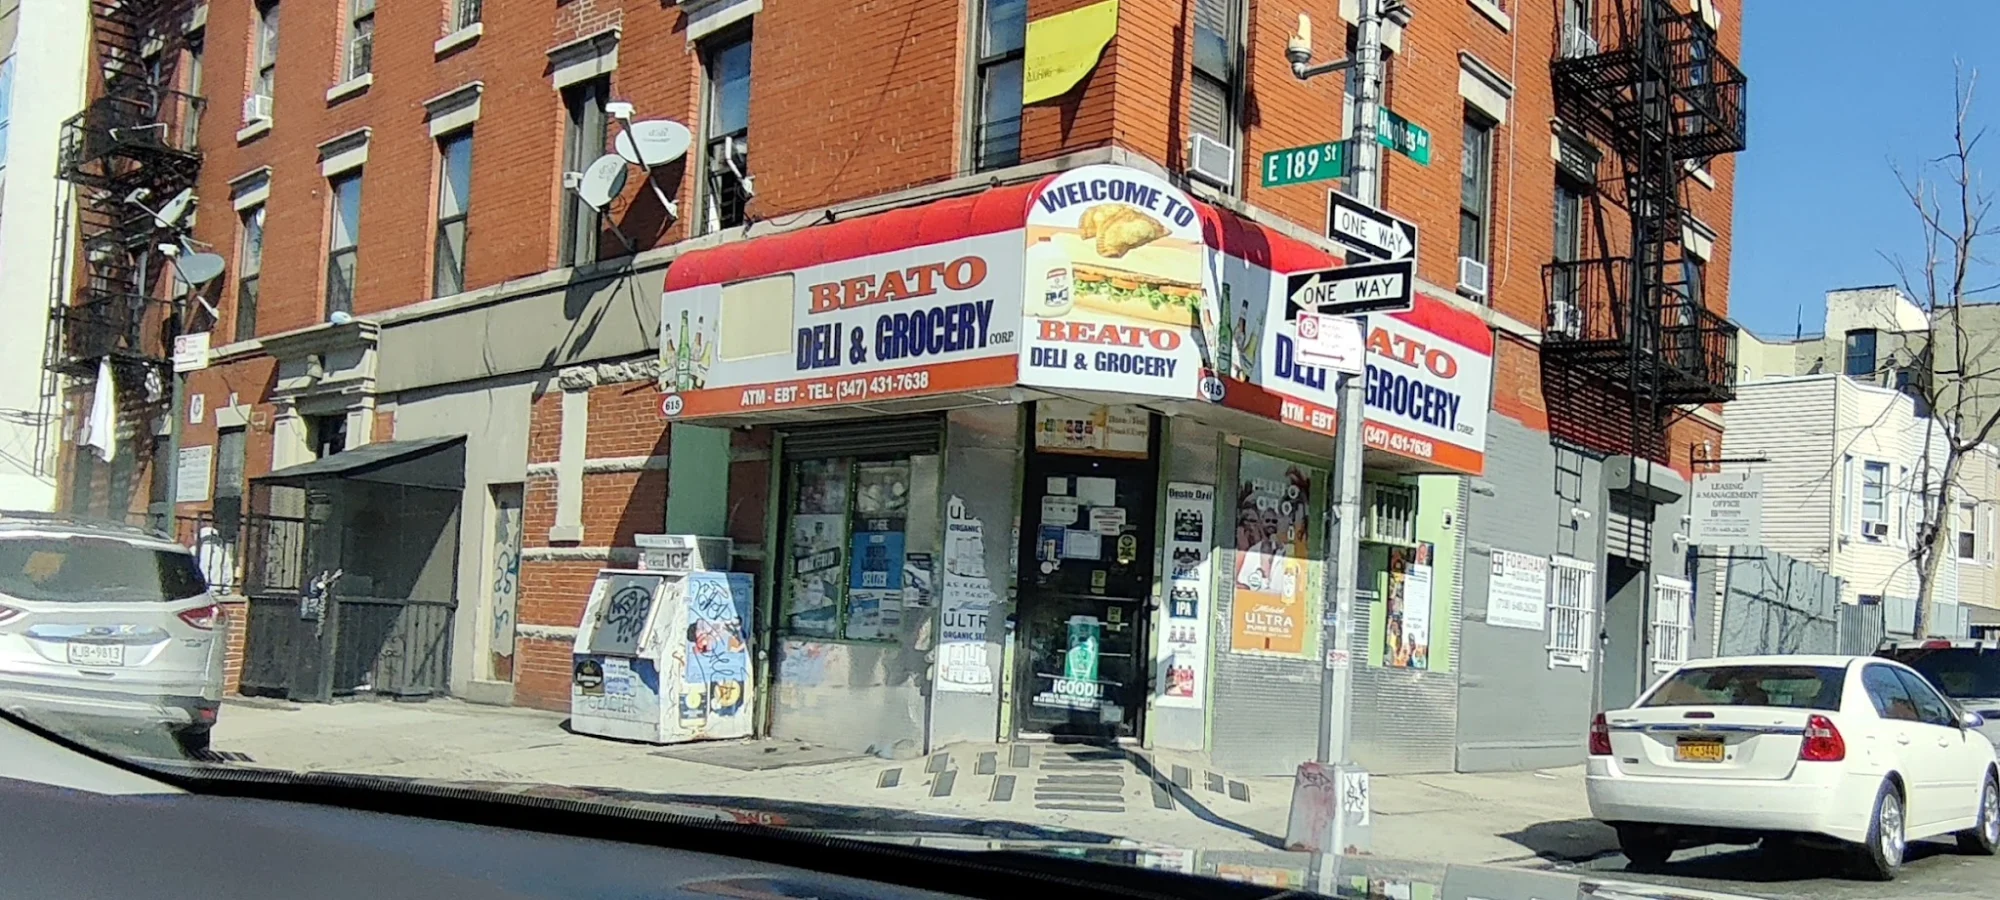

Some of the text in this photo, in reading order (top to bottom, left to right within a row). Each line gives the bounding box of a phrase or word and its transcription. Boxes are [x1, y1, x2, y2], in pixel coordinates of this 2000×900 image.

[1379, 109, 1427, 152] Hughes Av
[1268, 144, 1337, 182] E 189 St
[1038, 179, 1196, 228] WELCOME TO
[1342, 212, 1404, 252] ONE WAY
[808, 255, 988, 315] BEATO
[1303, 277, 1394, 305] ONE WAY
[797, 322, 842, 371] DELI
[849, 326, 868, 366] &
[875, 299, 995, 362] GROCERY
[1036, 319, 1182, 351] BEATO
[1030, 347, 1178, 378] DELI & GROCERY
[1366, 326, 1458, 380] ATO
[741, 390, 766, 407] ATM
[775, 387, 798, 403] EBT
[808, 383, 833, 400] TEL:
[836, 378, 868, 401] (347)
[870, 371, 929, 394] 431-7638
[1203, 382, 1223, 396] 615
[1364, 363, 1461, 432] GROCERY
[665, 401, 681, 411] 615
[1281, 401, 1304, 422] ATM
[1311, 409, 1335, 430] EBT
[1364, 424, 1433, 458] (347) 431-7638
[1702, 491, 1759, 499] MANAGEMENT
[1712, 500, 1741, 508] OFFICE
[667, 551, 690, 569] ICE
[1175, 600, 1193, 616] IPA
[1245, 611, 1294, 628] ULTRA
[942, 631, 974, 641] ORGANIC
